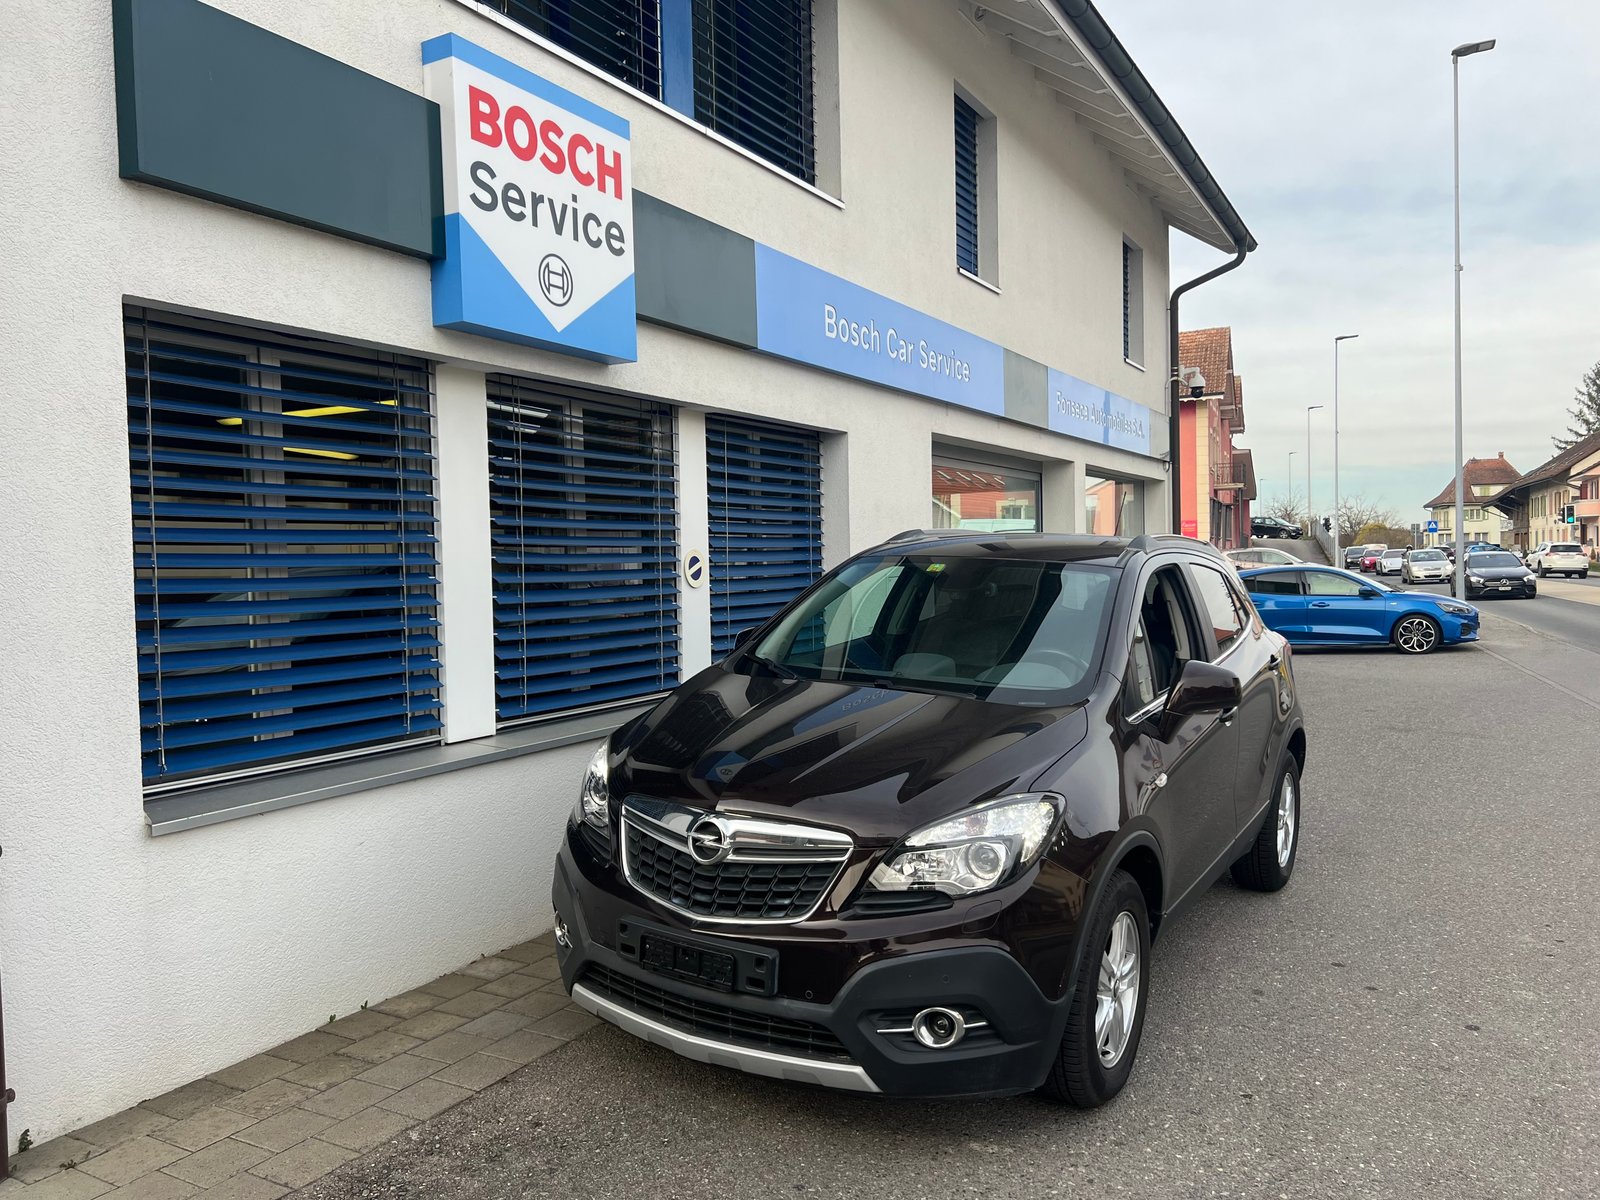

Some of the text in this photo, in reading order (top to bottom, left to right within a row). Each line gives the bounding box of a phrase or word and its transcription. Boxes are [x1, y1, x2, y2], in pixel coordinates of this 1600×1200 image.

[468, 84, 623, 200] BOSCH
[469, 160, 625, 257] Service
[824, 303, 971, 383] Bosch Car Service
[1056, 391, 1089, 421] Fonseca
[1091, 403, 1133, 435] Automobiles
